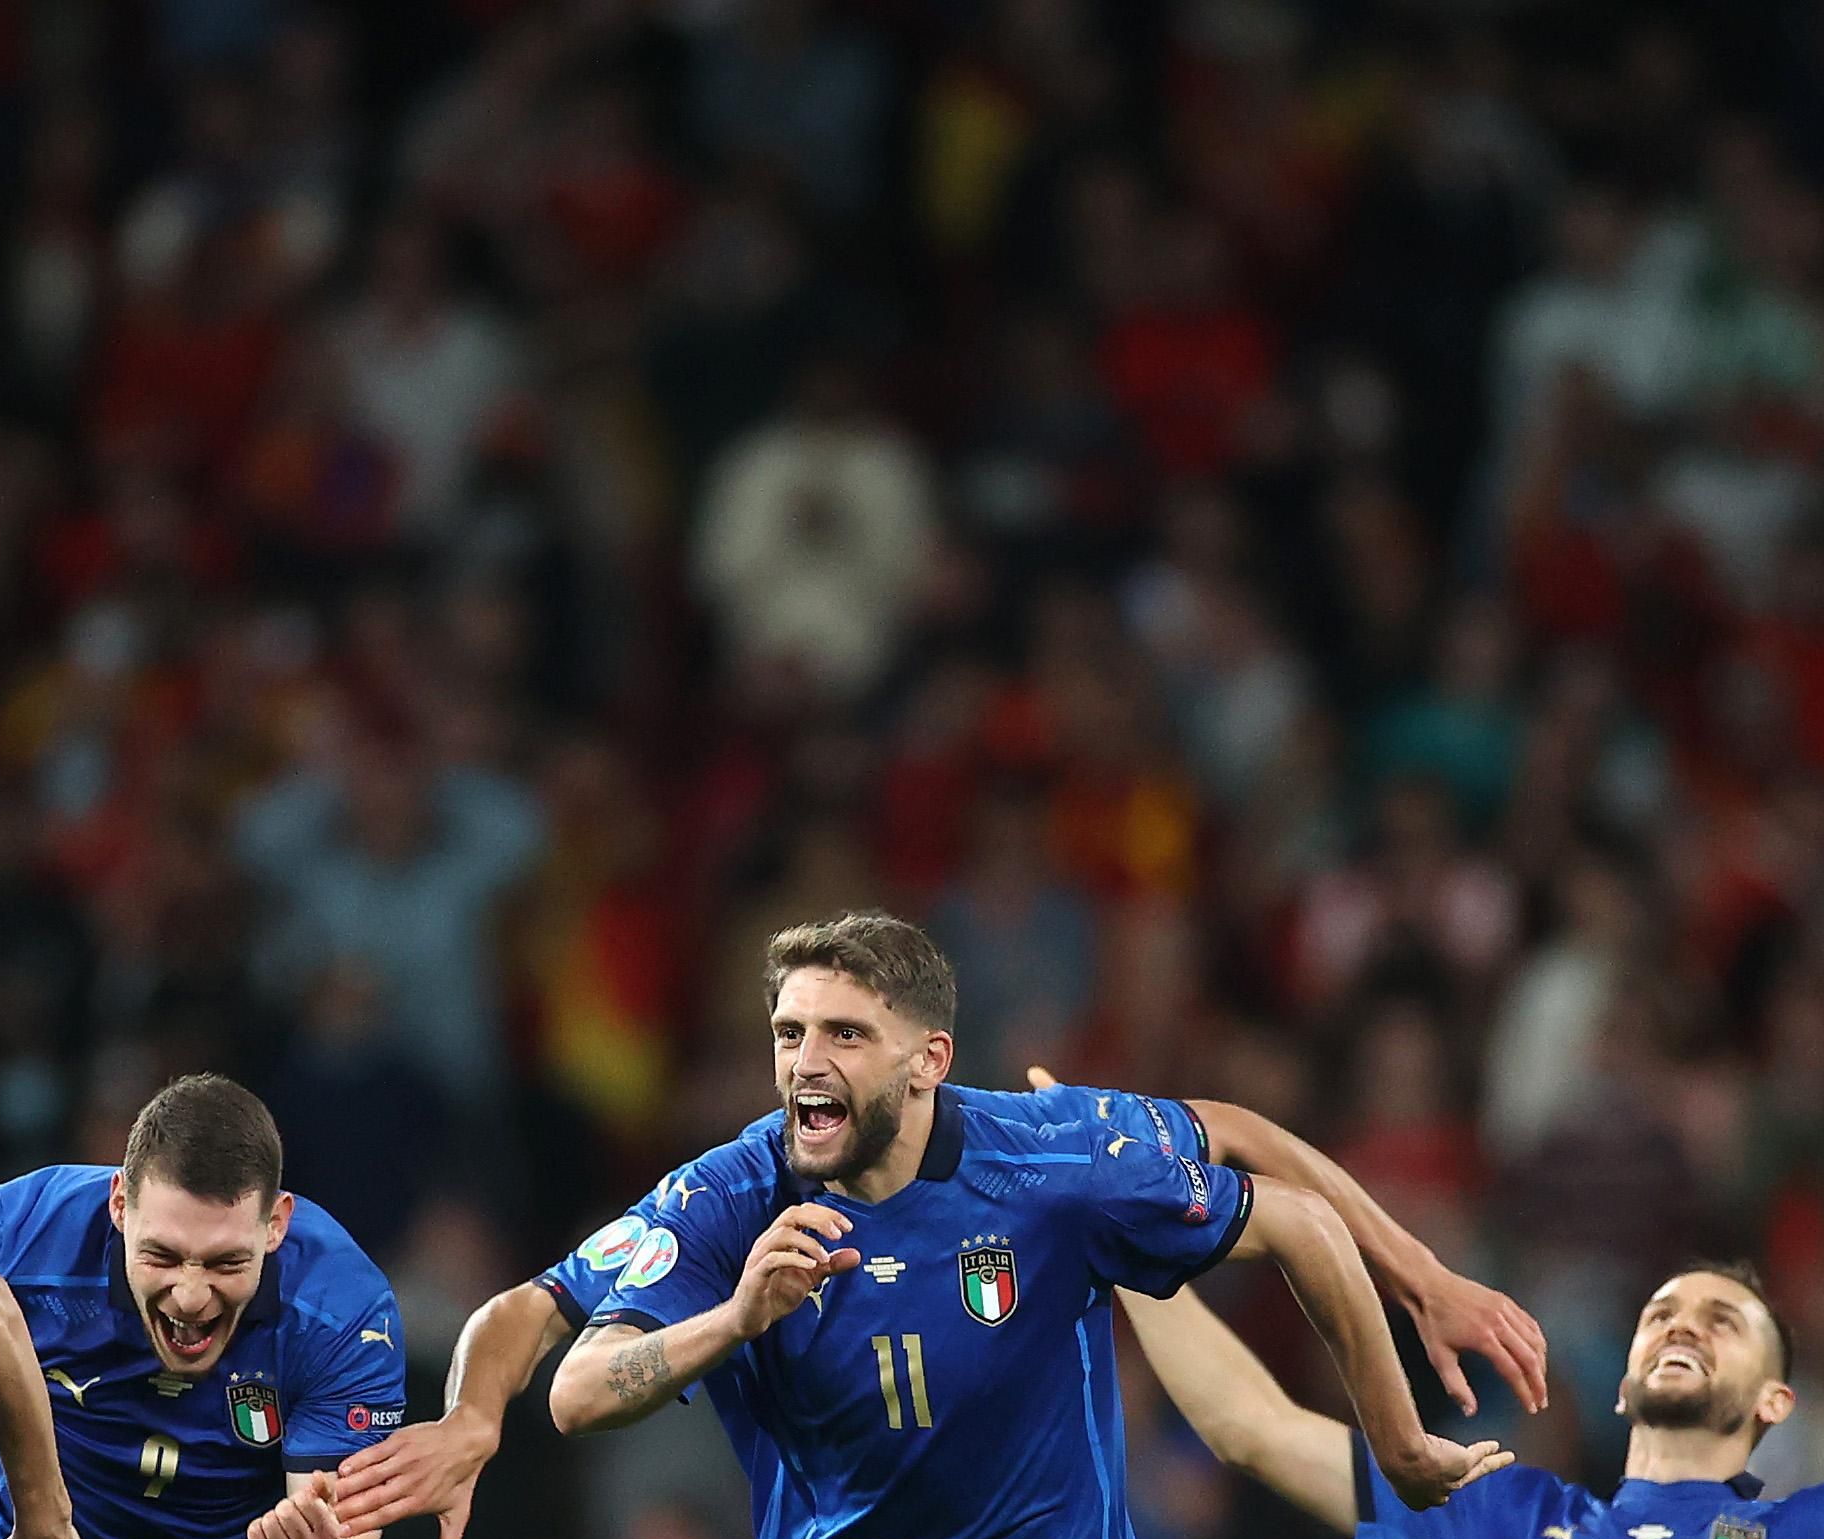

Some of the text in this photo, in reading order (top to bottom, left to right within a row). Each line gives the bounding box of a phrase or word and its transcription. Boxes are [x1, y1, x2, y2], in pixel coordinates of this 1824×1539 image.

[1179, 1155, 1206, 1205] RESPECT
[964, 1254, 1009, 1268] ITALIA
[232, 1387, 274, 1401] ITALIA
[871, 1333, 932, 1429] 11
[140, 1434, 179, 1499] 9
